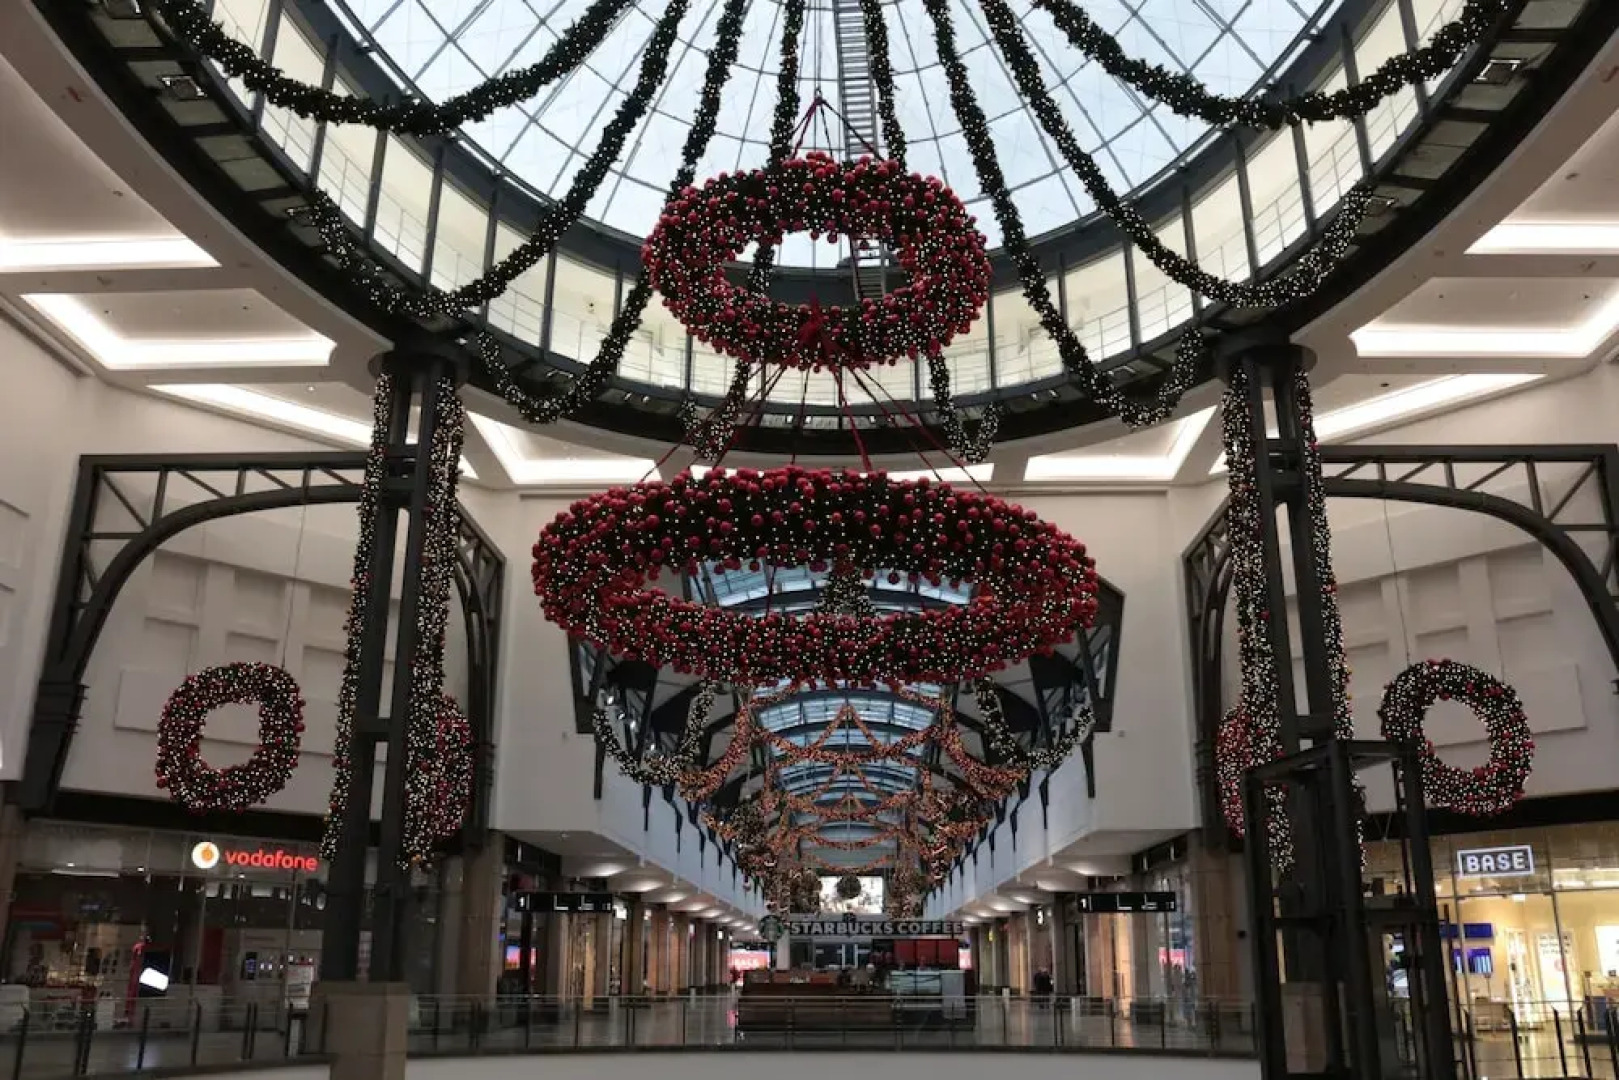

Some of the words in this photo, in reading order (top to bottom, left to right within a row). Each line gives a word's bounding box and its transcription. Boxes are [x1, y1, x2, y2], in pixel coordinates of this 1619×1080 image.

[225, 848, 318, 871] vodafone
[1466, 852, 1526, 872] BASE
[790, 922, 893, 935] STARBUCKS
[897, 921, 963, 935] COFFEE
